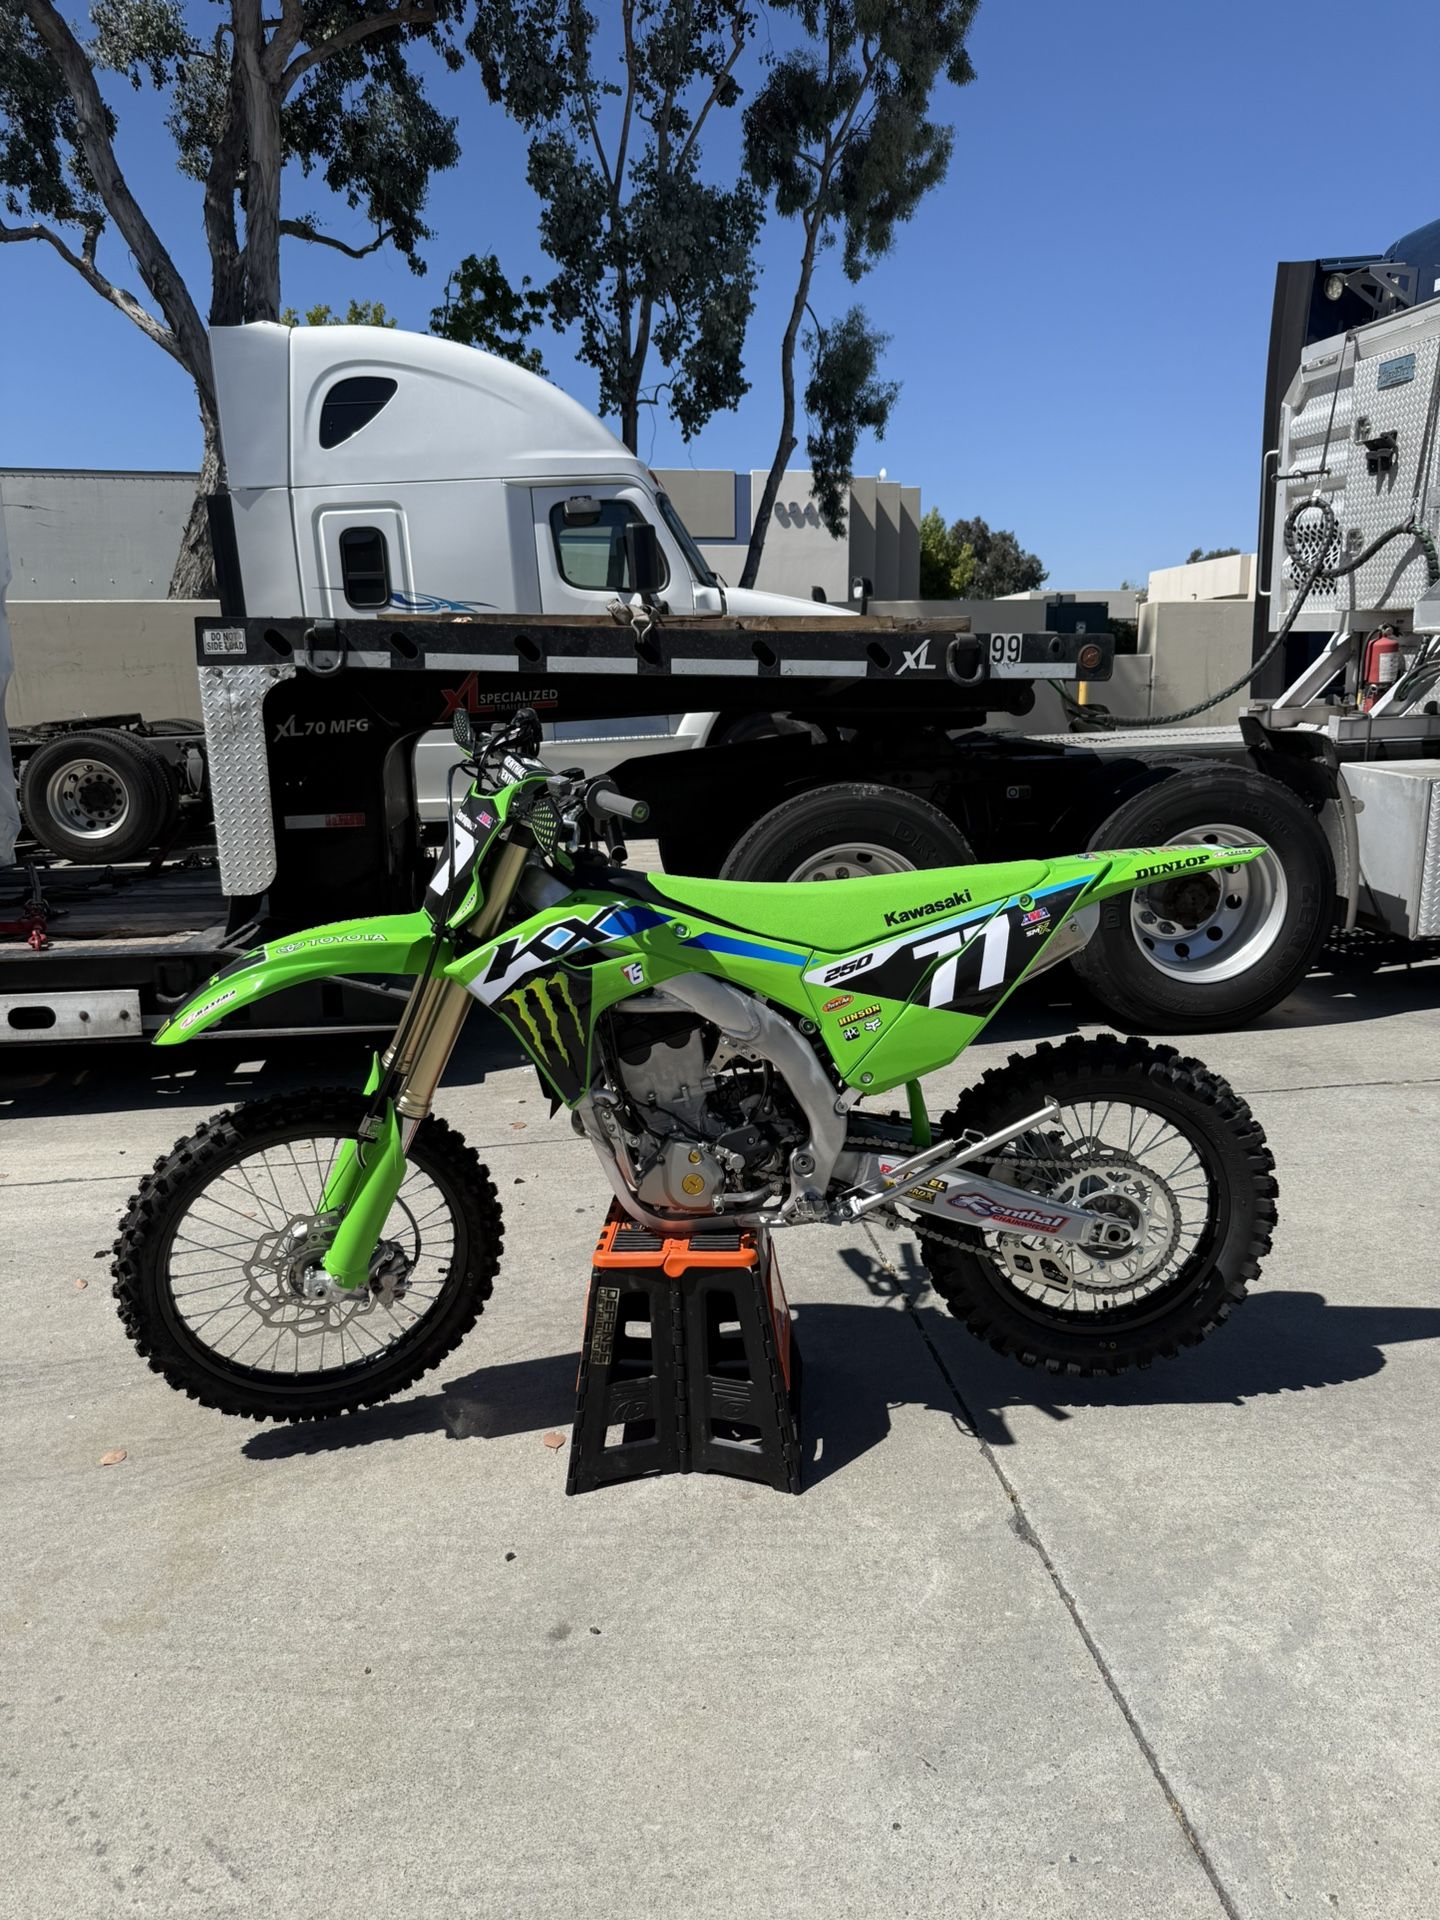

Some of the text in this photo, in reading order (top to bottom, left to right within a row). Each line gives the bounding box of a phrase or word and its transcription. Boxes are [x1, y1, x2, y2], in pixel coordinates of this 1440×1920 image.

[206, 641, 223, 650] SIDE
[210, 632, 222, 641] DO
[991, 634, 1021, 663] 99
[895, 639, 937, 676] XL
[479, 689, 558, 704] SPECIALIZED
[330, 719, 369, 734] MFG
[1134, 854, 1210, 881] DUNLOP
[883, 888, 973, 927] Kawasaki
[307, 933, 388, 946] TOYOTA
[823, 953, 874, 983] 250
[838, 1004, 881, 1026] HINSON
[949, 1194, 1064, 1227] Renthal
[591, 1288, 607, 1363] DISTRIBUTORS
[599, 1288, 618, 1364] DEFENSE
